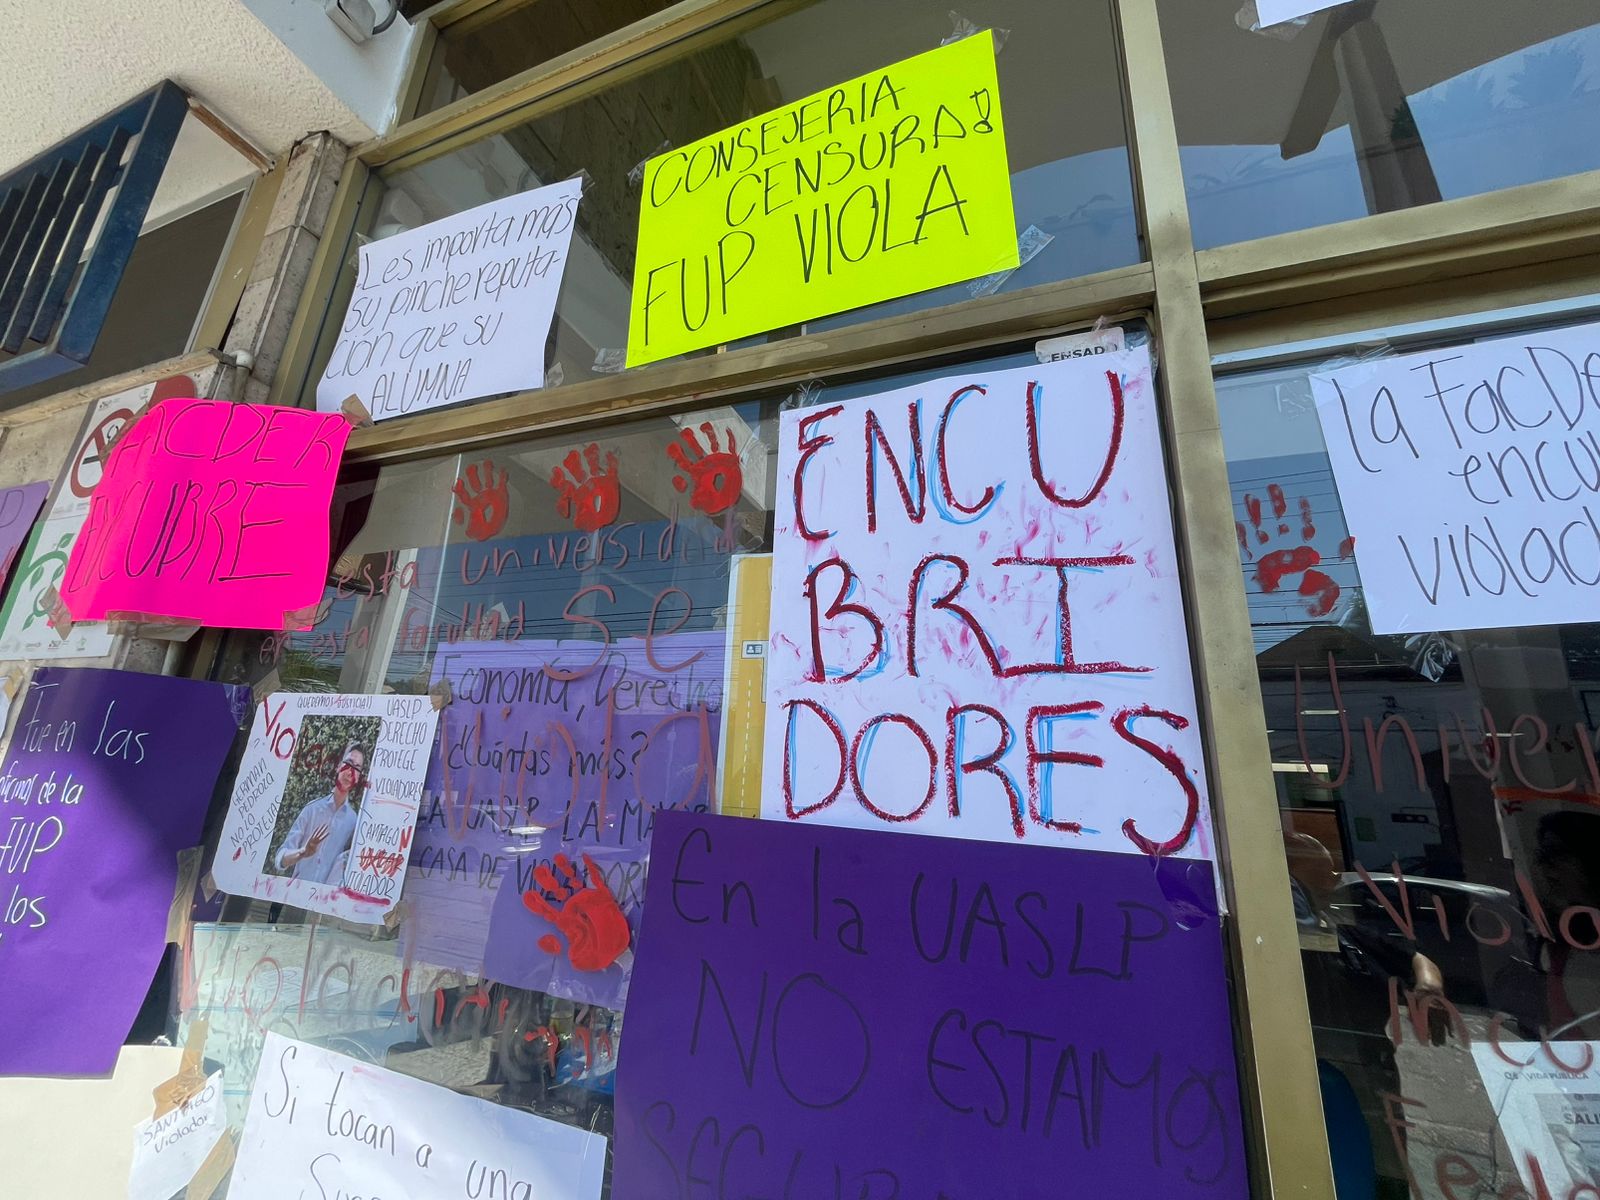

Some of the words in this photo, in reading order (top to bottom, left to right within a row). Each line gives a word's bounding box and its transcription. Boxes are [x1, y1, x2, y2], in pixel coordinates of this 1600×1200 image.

[651, 75, 905, 208] CONSEJERIA
[356, 250, 413, 291] Les
[420, 211, 515, 273] importa
[643, 231, 755, 346] FUP
[794, 165, 968, 283] VIOLA
[344, 296, 382, 333] su
[399, 321, 458, 373] que
[463, 311, 503, 347] su
[1041, 343, 1118, 363] ENSAD
[793, 370, 1127, 540] ENCU
[1331, 378, 1419, 473] la
[336, 550, 420, 602] esta
[802, 553, 1160, 685] BRI
[93, 700, 150, 764] las
[386, 698, 423, 719] UASLP
[60, 773, 84, 805] la
[781, 697, 1199, 856] DORES
[4, 884, 46, 927] los
[672, 828, 759, 927] En
[810, 846, 869, 956] la
[910, 872, 1169, 981] UASLP
[690, 959, 871, 1110] NO
[264, 1045, 298, 1124] Si
[325, 1071, 395, 1156] tocan
